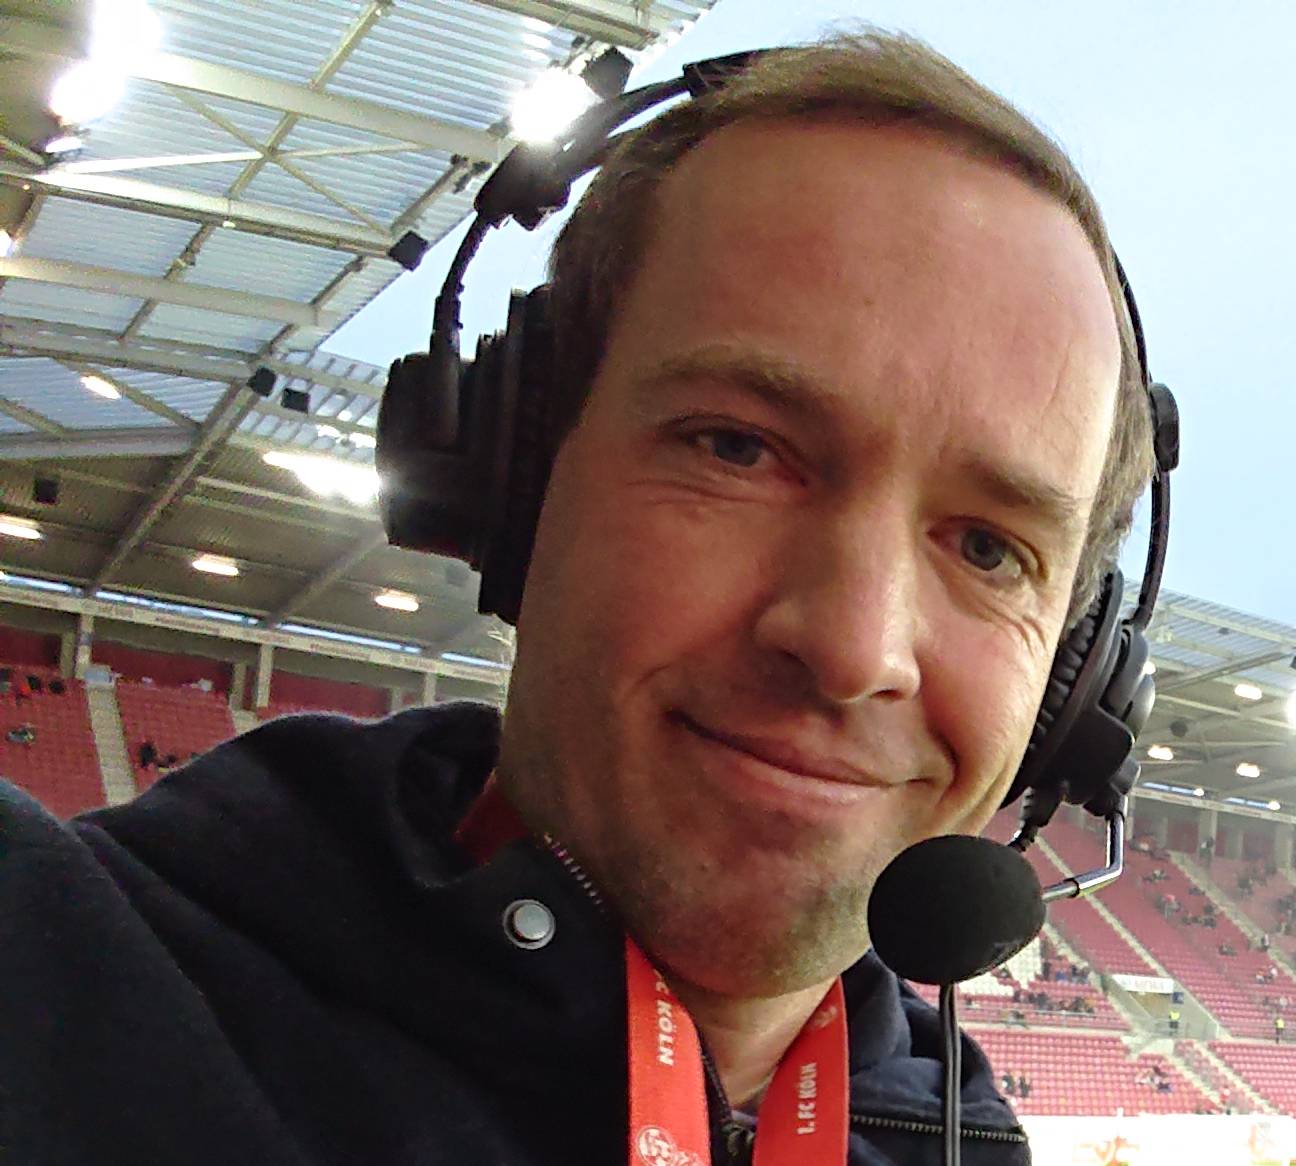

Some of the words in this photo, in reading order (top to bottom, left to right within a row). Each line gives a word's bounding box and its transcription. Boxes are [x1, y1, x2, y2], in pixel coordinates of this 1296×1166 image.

[656, 1000, 676, 1066] KÖLN
[795, 1062, 818, 1100] KÖLN
[797, 1102, 816, 1120] FC
